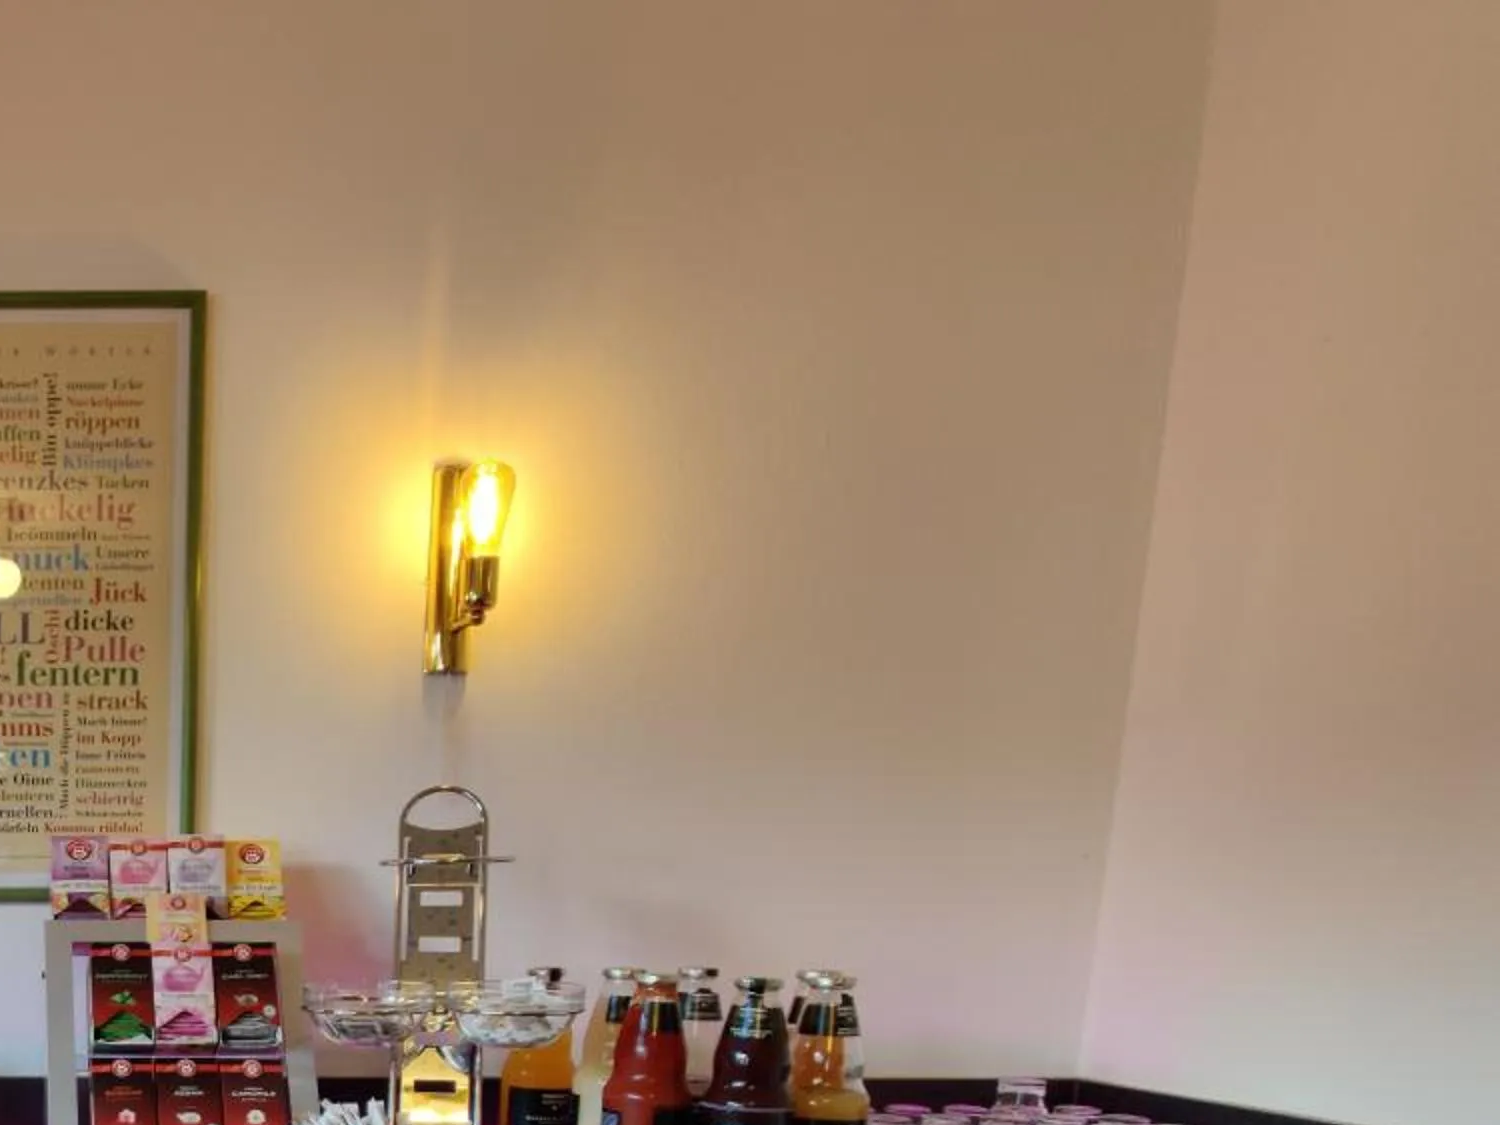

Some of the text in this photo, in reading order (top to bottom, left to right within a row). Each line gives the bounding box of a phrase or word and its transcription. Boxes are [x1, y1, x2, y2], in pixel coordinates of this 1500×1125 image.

[65, 411, 141, 435] röppen
[7, 525, 98, 543] beömmeln
[88, 576, 149, 607] Jück
[63, 609, 135, 632] dicke
[43, 608, 63, 665] Oschi
[62, 635, 146, 664] Pulle
[75, 688, 149, 711] strack
[76, 731, 142, 747] im Kopp
